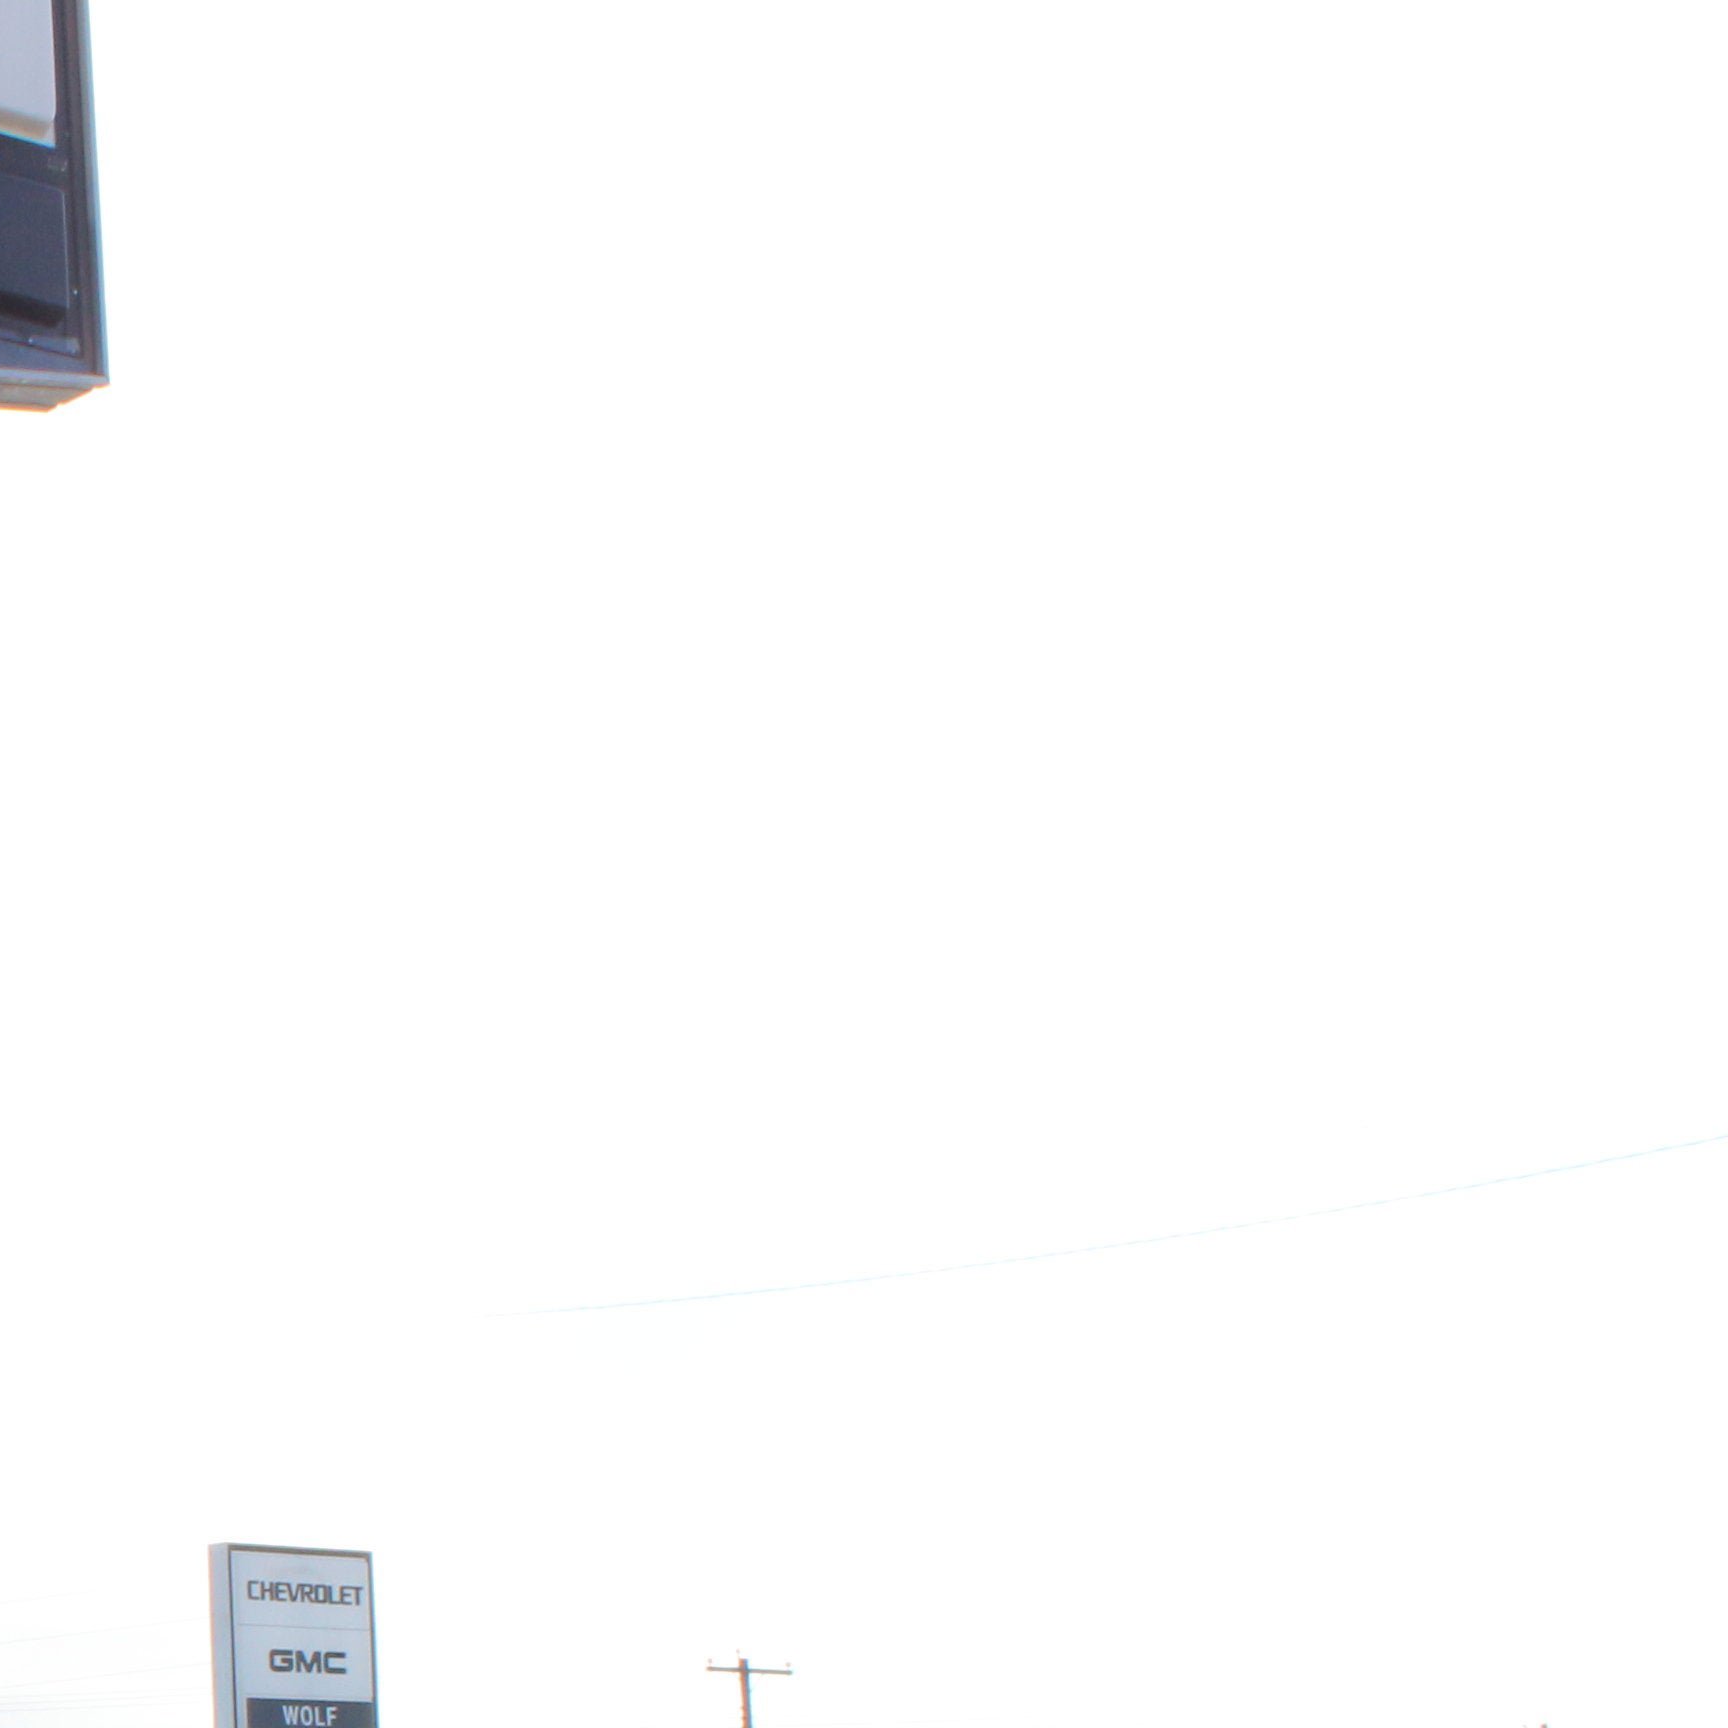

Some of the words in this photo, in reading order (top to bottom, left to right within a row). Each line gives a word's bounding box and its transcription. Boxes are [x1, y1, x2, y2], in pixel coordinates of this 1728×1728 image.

[247, 1580, 363, 1606] CHEVROLET
[269, 1648, 347, 1675] GMC
[282, 1704, 338, 1727] WOLF
